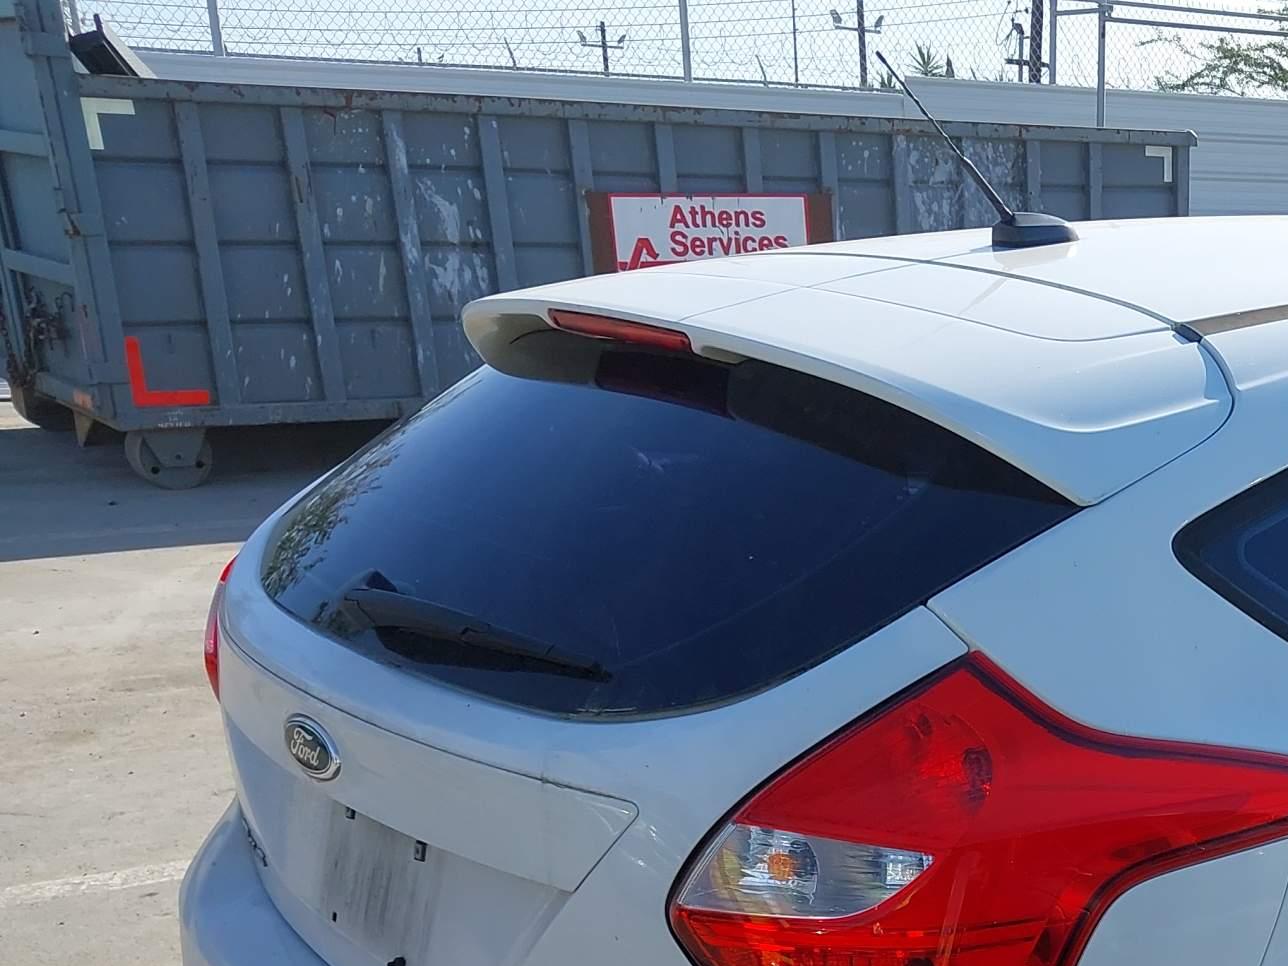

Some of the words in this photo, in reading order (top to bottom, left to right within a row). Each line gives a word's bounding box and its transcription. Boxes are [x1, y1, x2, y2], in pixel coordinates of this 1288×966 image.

[669, 204, 766, 229] Athens
[670, 230, 789, 257] Services
[290, 727, 321, 766] Ford
